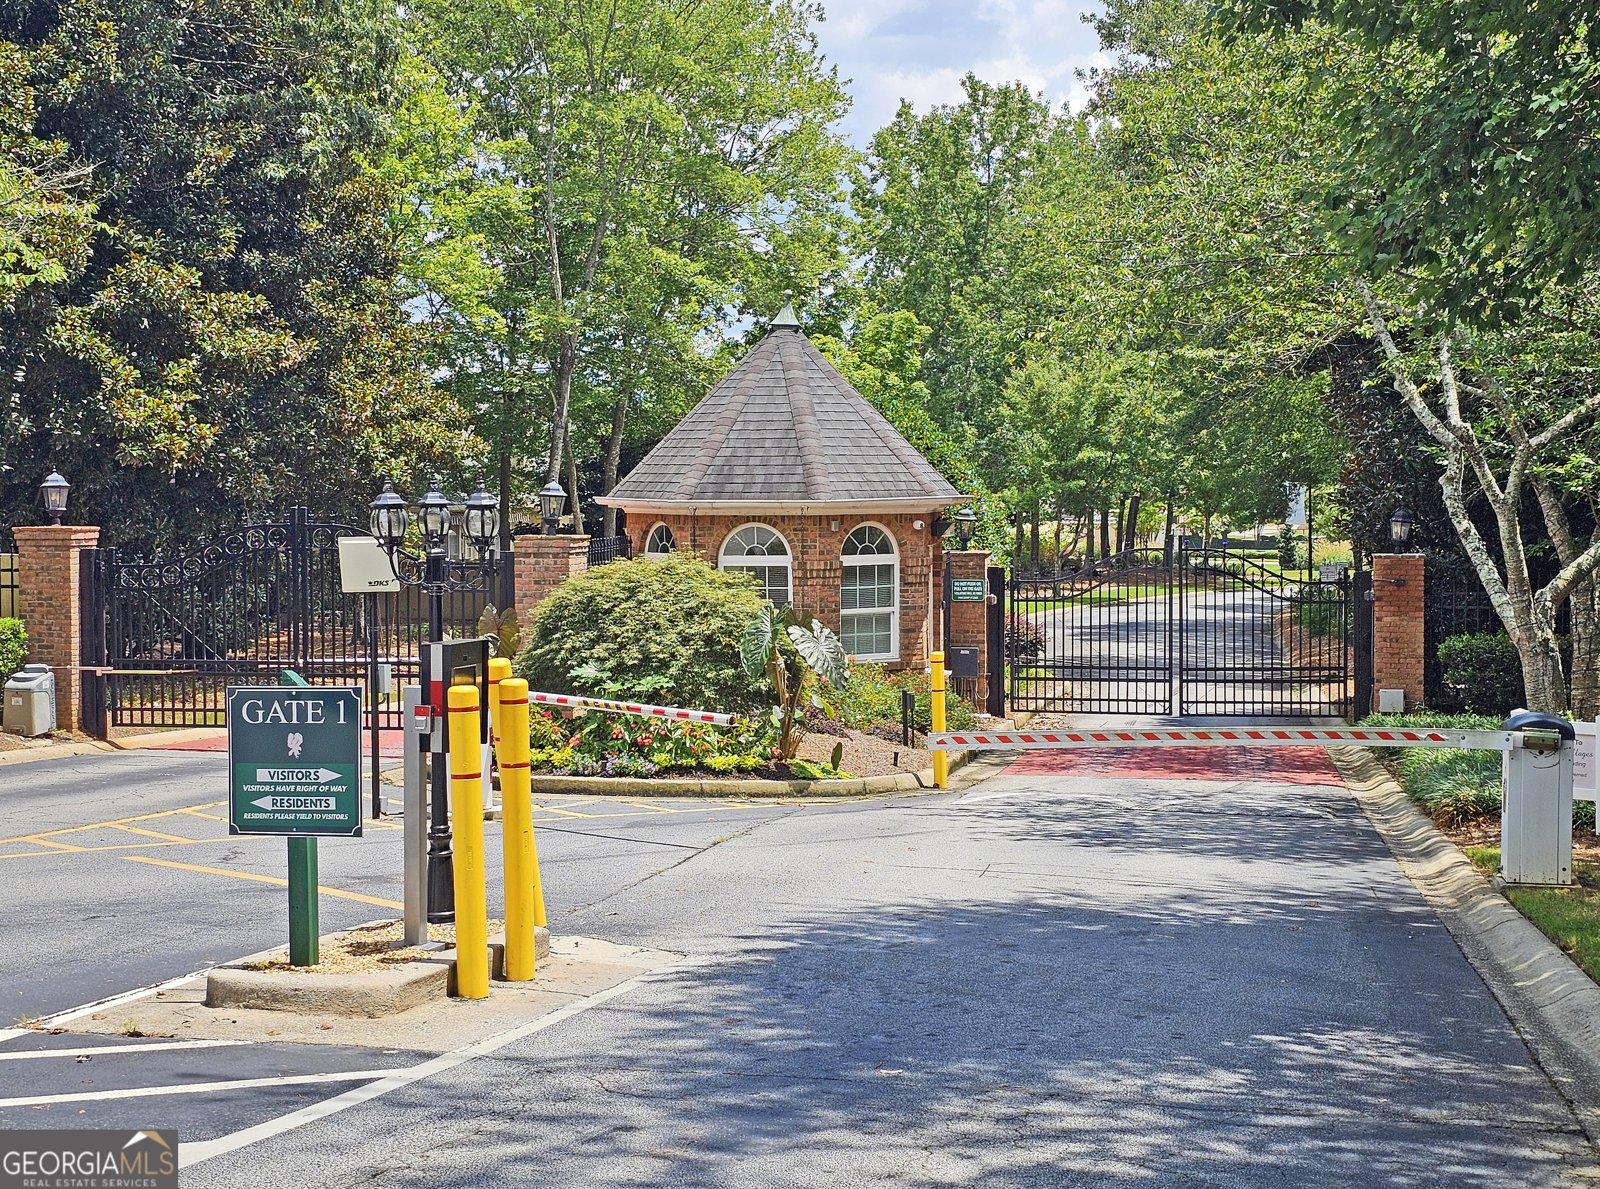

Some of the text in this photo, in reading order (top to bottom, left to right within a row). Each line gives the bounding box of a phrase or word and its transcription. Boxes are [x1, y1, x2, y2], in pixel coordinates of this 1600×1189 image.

[241, 699, 347, 724] GATE 1
[268, 770, 320, 781] VISITORS
[330, 785, 348, 793] WAY
[271, 798, 331, 809] RESIDENTS
